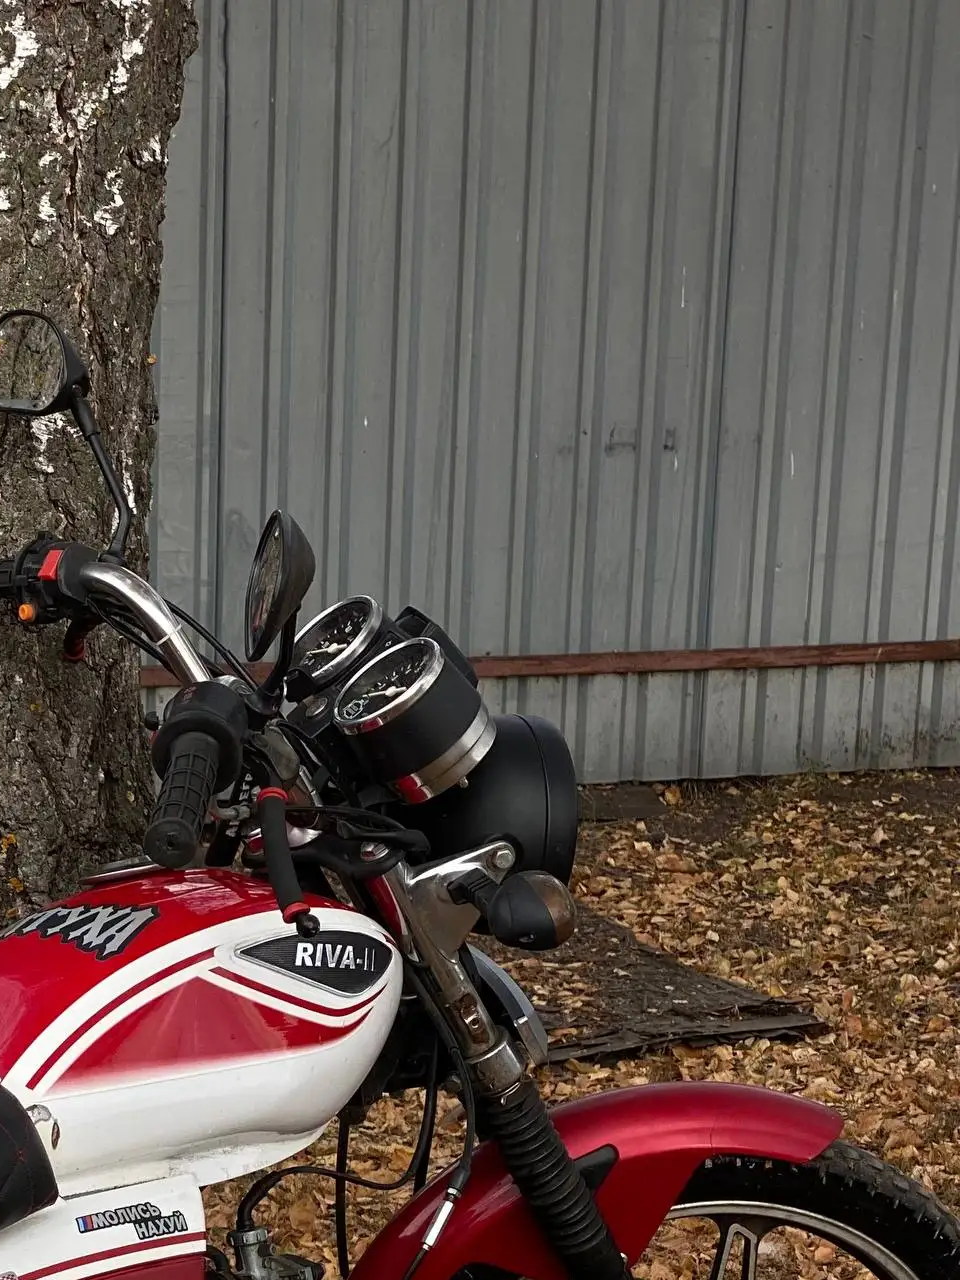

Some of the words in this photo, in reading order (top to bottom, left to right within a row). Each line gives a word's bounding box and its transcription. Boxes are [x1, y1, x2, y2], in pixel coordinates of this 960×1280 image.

[295, 942, 375, 972] RIVA-II
[91, 1203, 160, 1229] МОЛИСЬ
[135, 1212, 187, 1238] НАХУЙ
